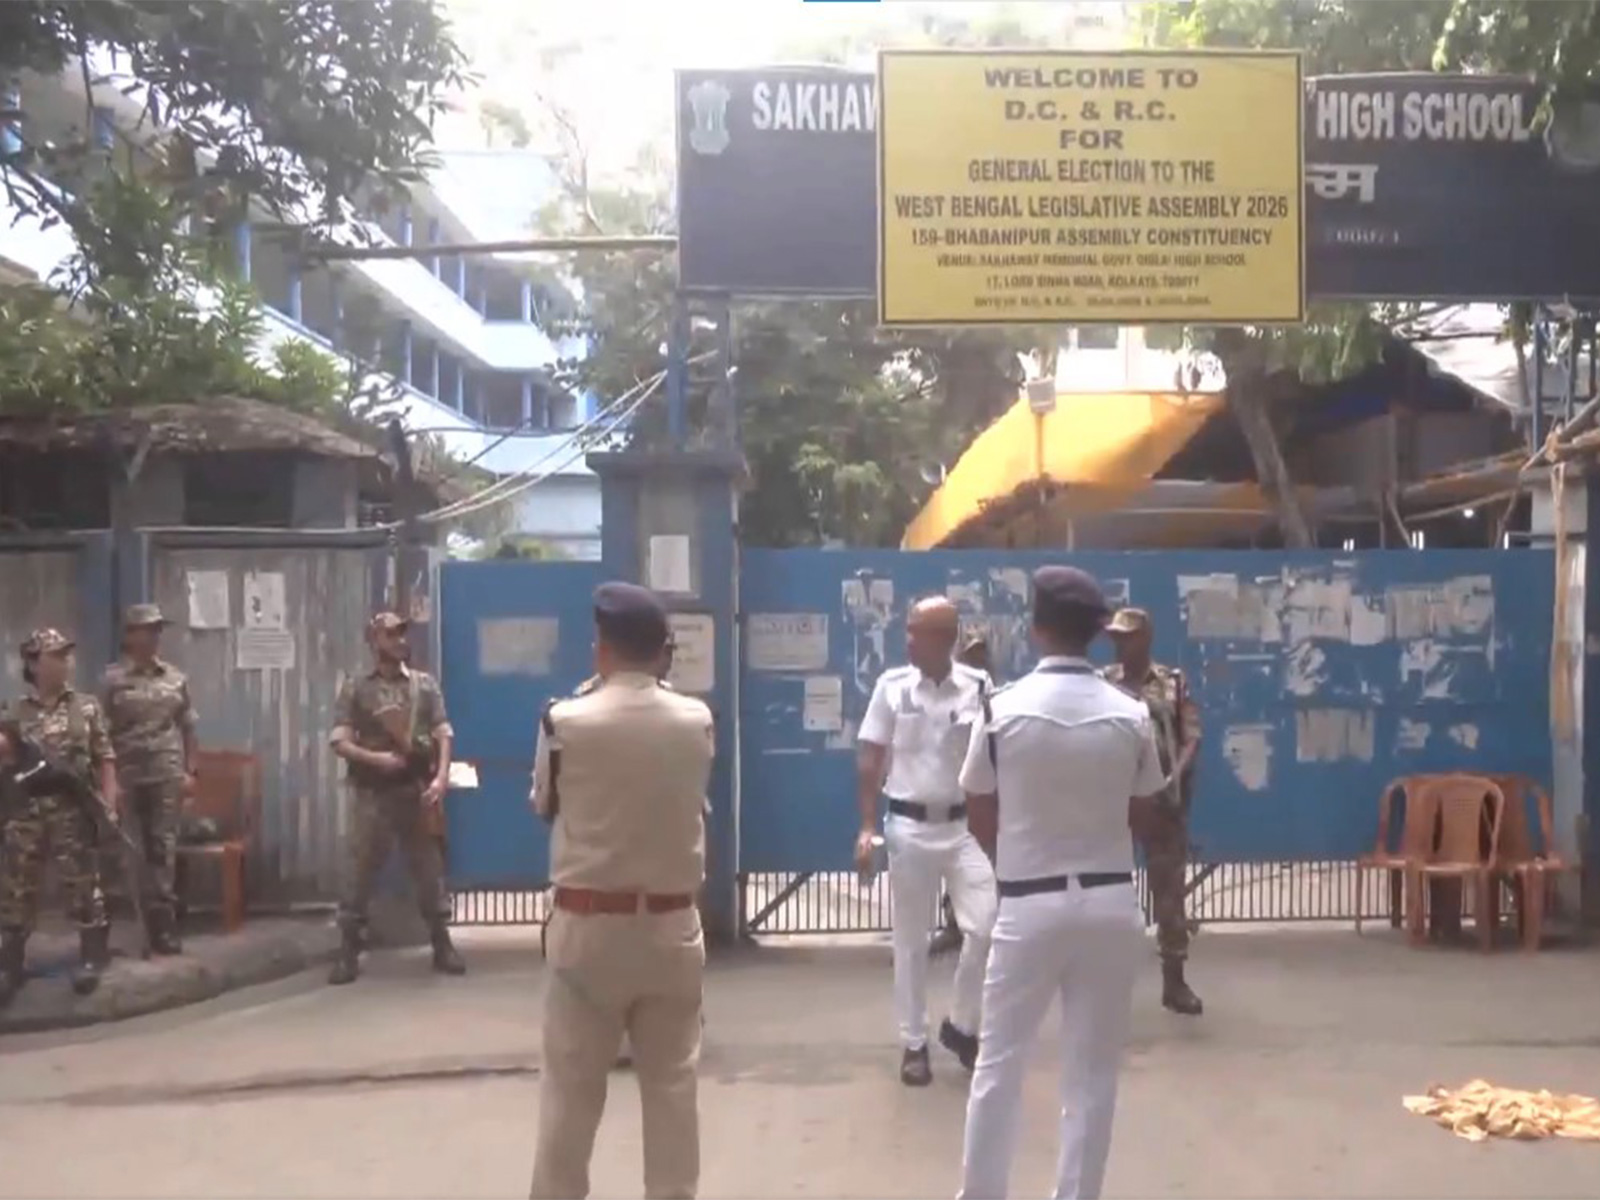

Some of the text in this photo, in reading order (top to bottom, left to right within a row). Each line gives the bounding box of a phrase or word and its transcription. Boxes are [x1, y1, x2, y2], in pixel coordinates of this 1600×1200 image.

[984, 68, 1199, 89] WELCOME TO
[1004, 101, 1176, 121] D.C. & R.C.
[1316, 91, 1530, 141] HIGH SCHOOL
[1059, 129, 1124, 150] FOR
[968, 159, 1215, 183] GENERAL ELECTION TO THE
[895, 195, 1288, 218] WEST BENGAL LEGISLATIVE ASSEMBLY 2026
[911, 228, 1273, 246] 159-BHABANIPUR ASSEMBLY CONSTITUENCY
